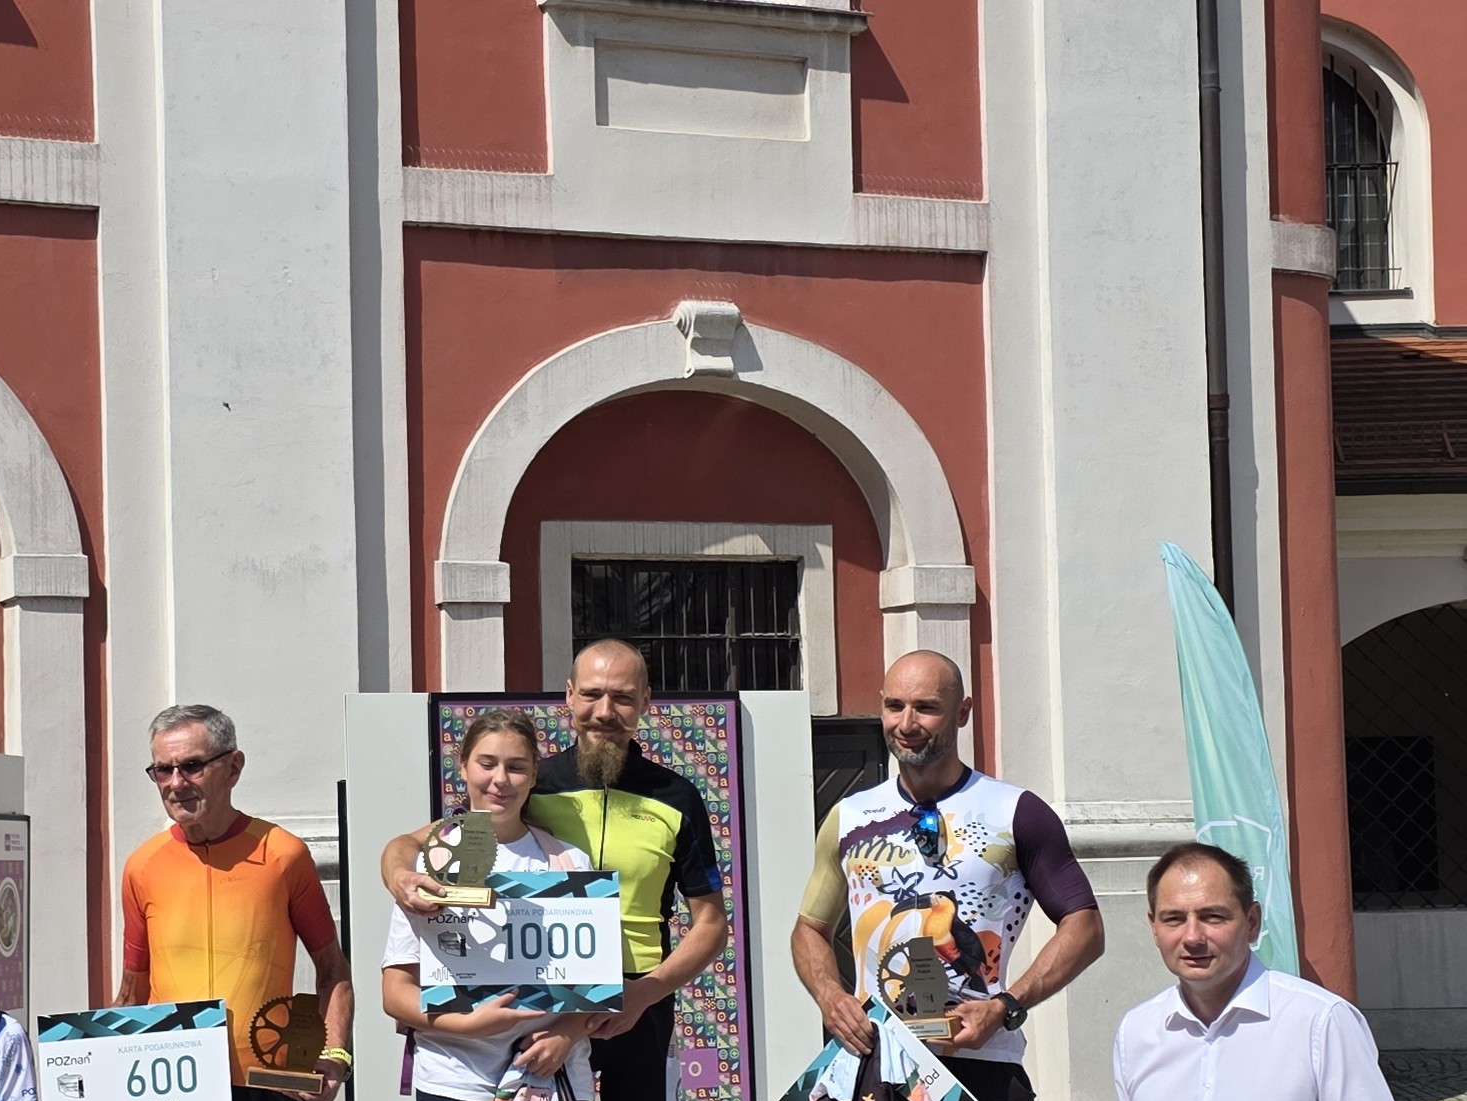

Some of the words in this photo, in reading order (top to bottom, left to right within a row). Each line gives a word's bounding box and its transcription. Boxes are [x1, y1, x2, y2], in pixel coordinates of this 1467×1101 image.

[502, 923, 596, 960] 1000
[536, 967, 566, 980] PLN
[144, 1040, 202, 1052] PODARUNKOWA
[47, 1055, 90, 1067] POZnań
[127, 1055, 197, 1097] 600
